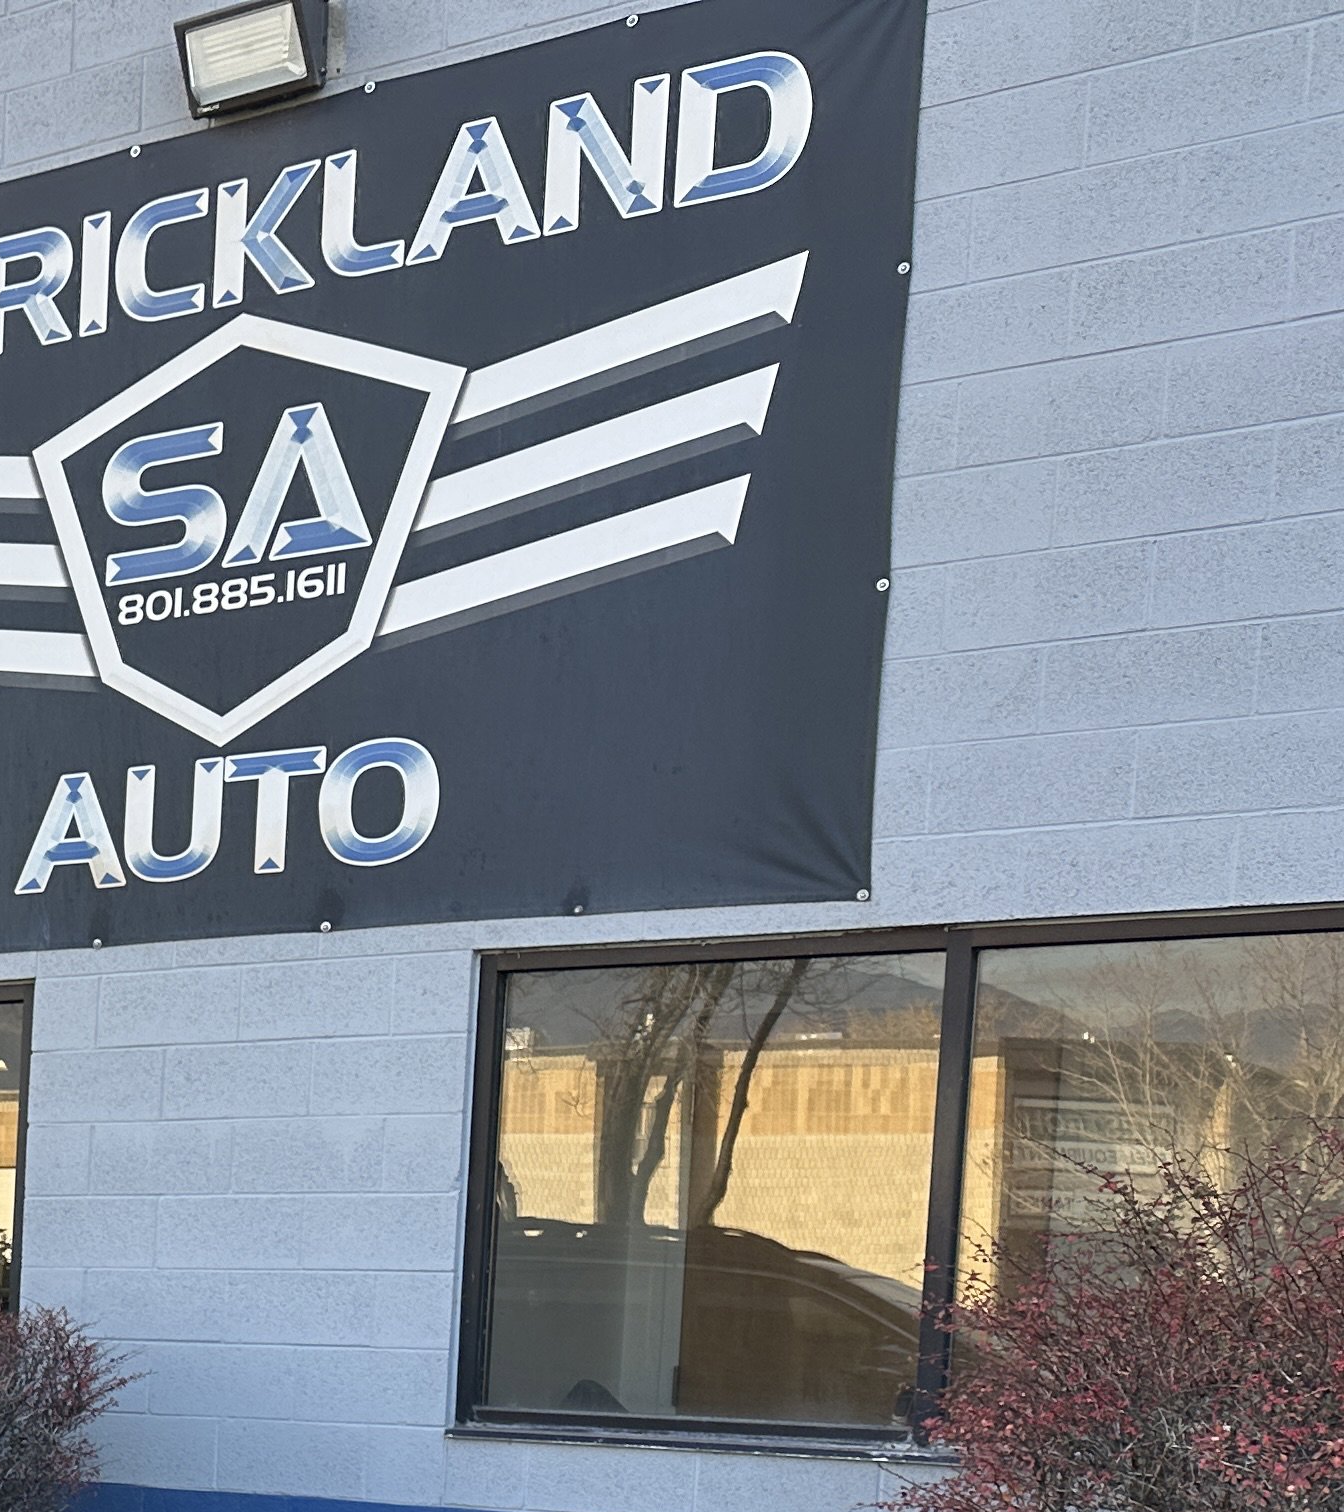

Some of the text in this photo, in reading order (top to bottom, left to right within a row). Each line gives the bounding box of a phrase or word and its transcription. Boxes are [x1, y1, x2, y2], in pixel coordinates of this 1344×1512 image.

[104, 402, 373, 587] SA
[118, 562, 347, 628] 801.885.1611
[14, 736, 441, 896] AUTO
